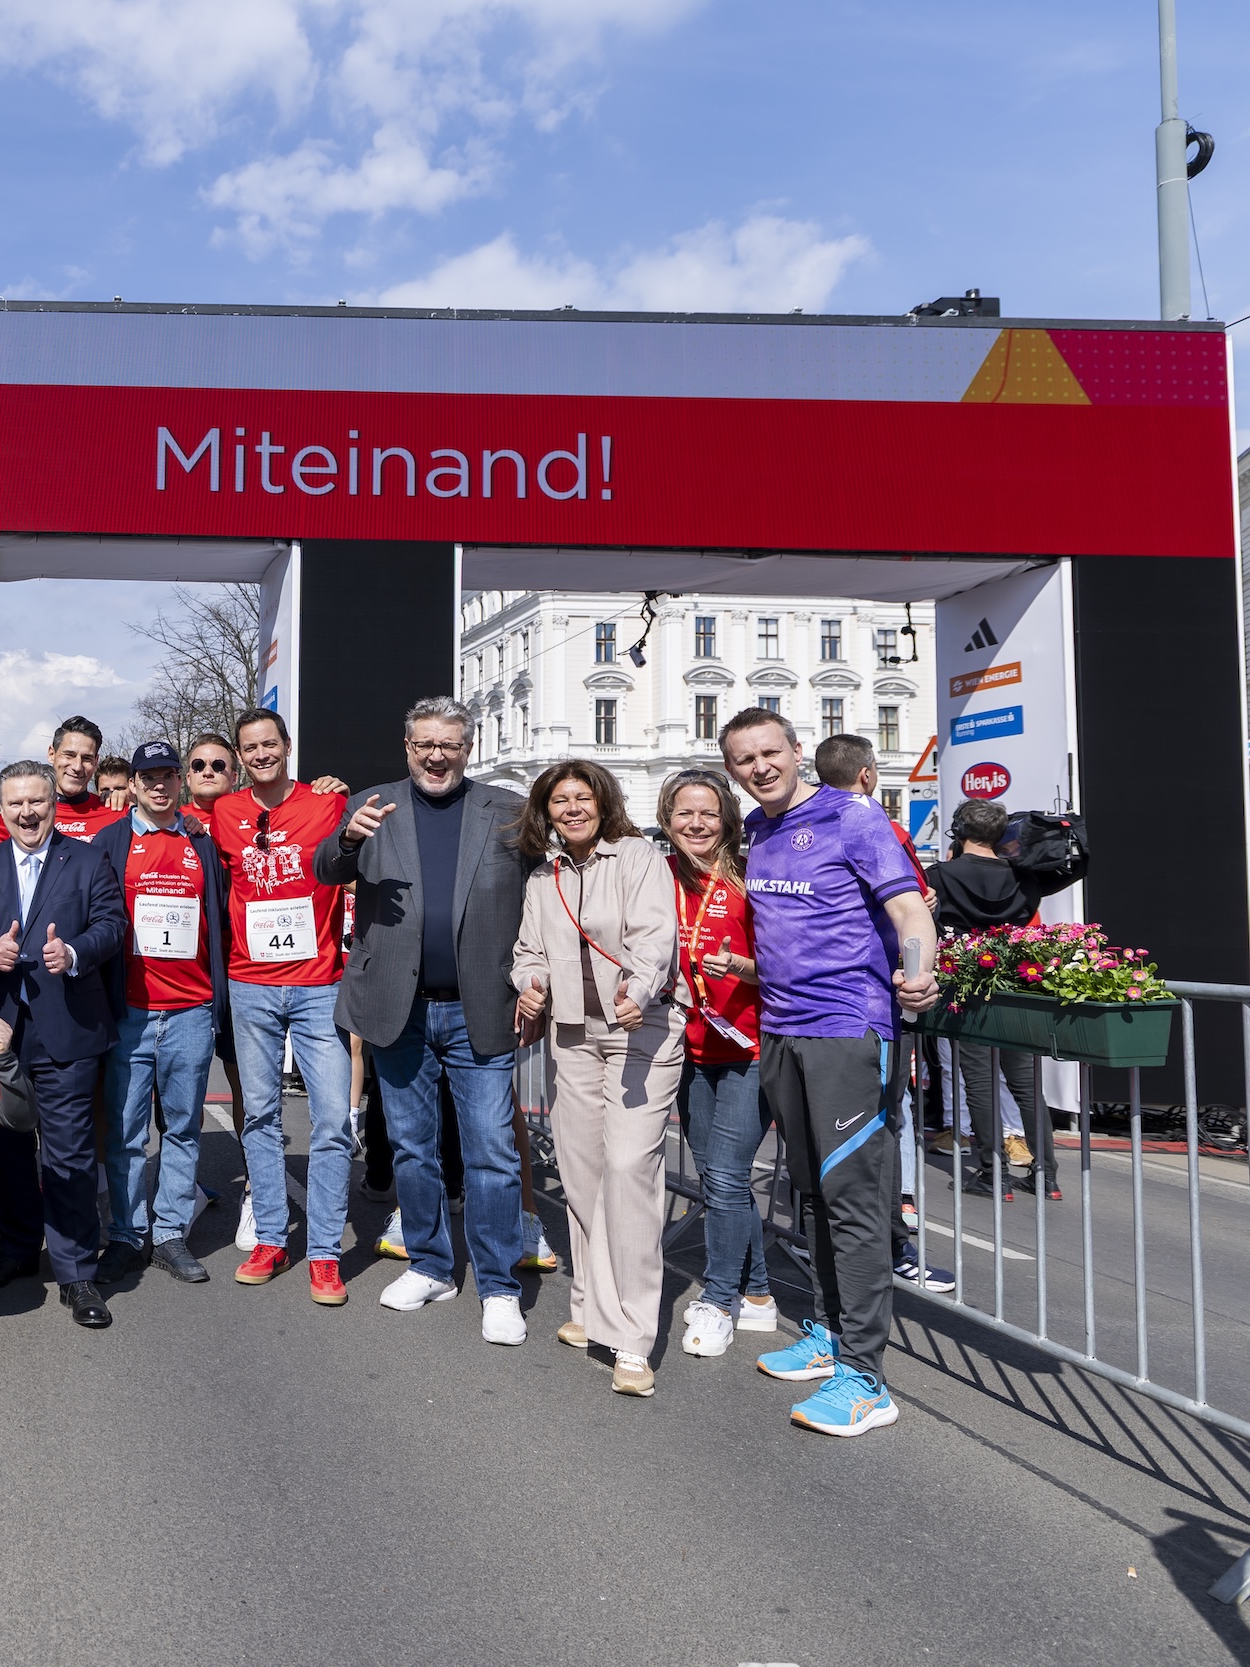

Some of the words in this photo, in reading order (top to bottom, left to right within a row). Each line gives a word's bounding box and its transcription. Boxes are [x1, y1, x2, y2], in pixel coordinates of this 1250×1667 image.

[156, 426, 612, 500] Miteinand!
[984, 668, 1019, 683] ENERGIE
[964, 771, 1008, 793] Hervis
[55, 821, 88, 833] Coca-Cola
[134, 880, 155, 888] Laufend
[145, 886, 187, 896] Miteinand!
[162, 930, 172, 946] 1
[268, 933, 296, 950] 44
